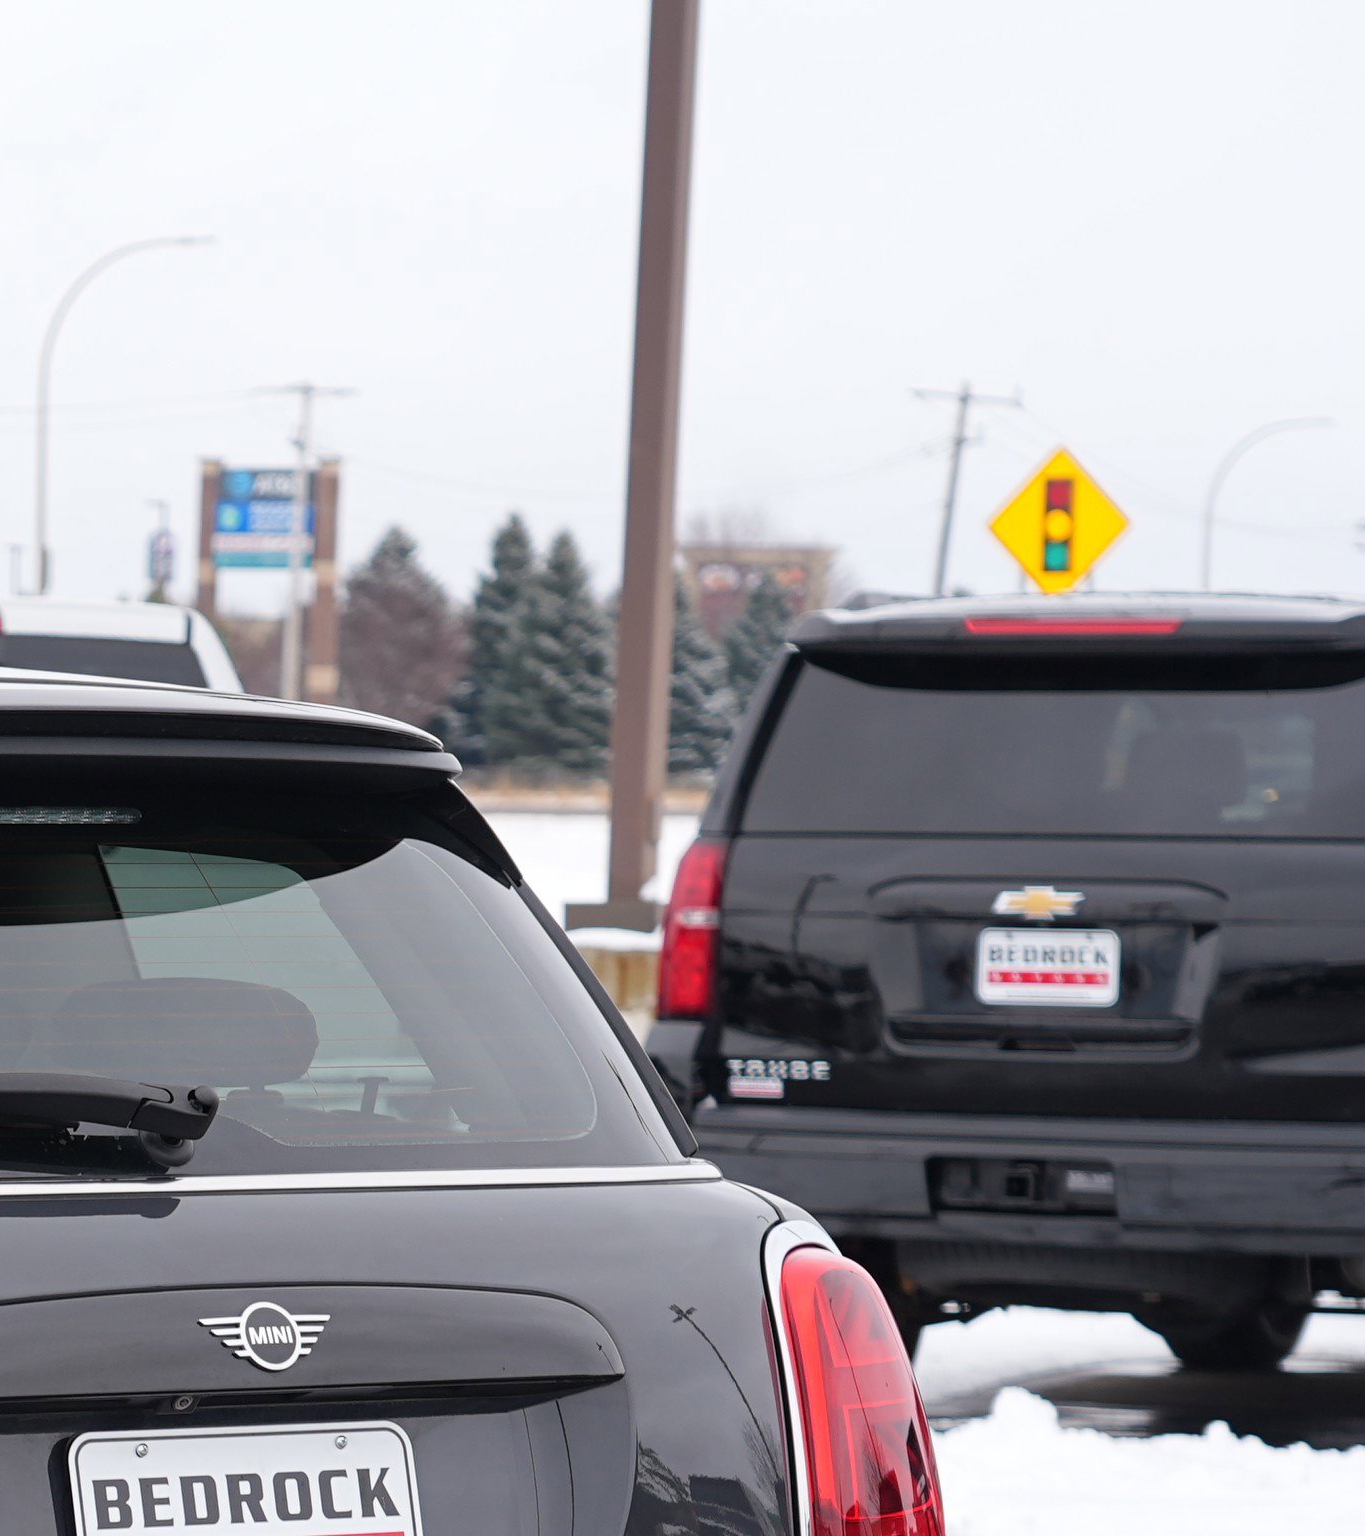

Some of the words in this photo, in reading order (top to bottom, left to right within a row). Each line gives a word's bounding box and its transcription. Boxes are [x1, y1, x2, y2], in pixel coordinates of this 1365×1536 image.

[988, 944, 1108, 964] BEDROCK
[249, 1325, 293, 1345] MINI
[92, 1467, 400, 1529] BEDROCK
